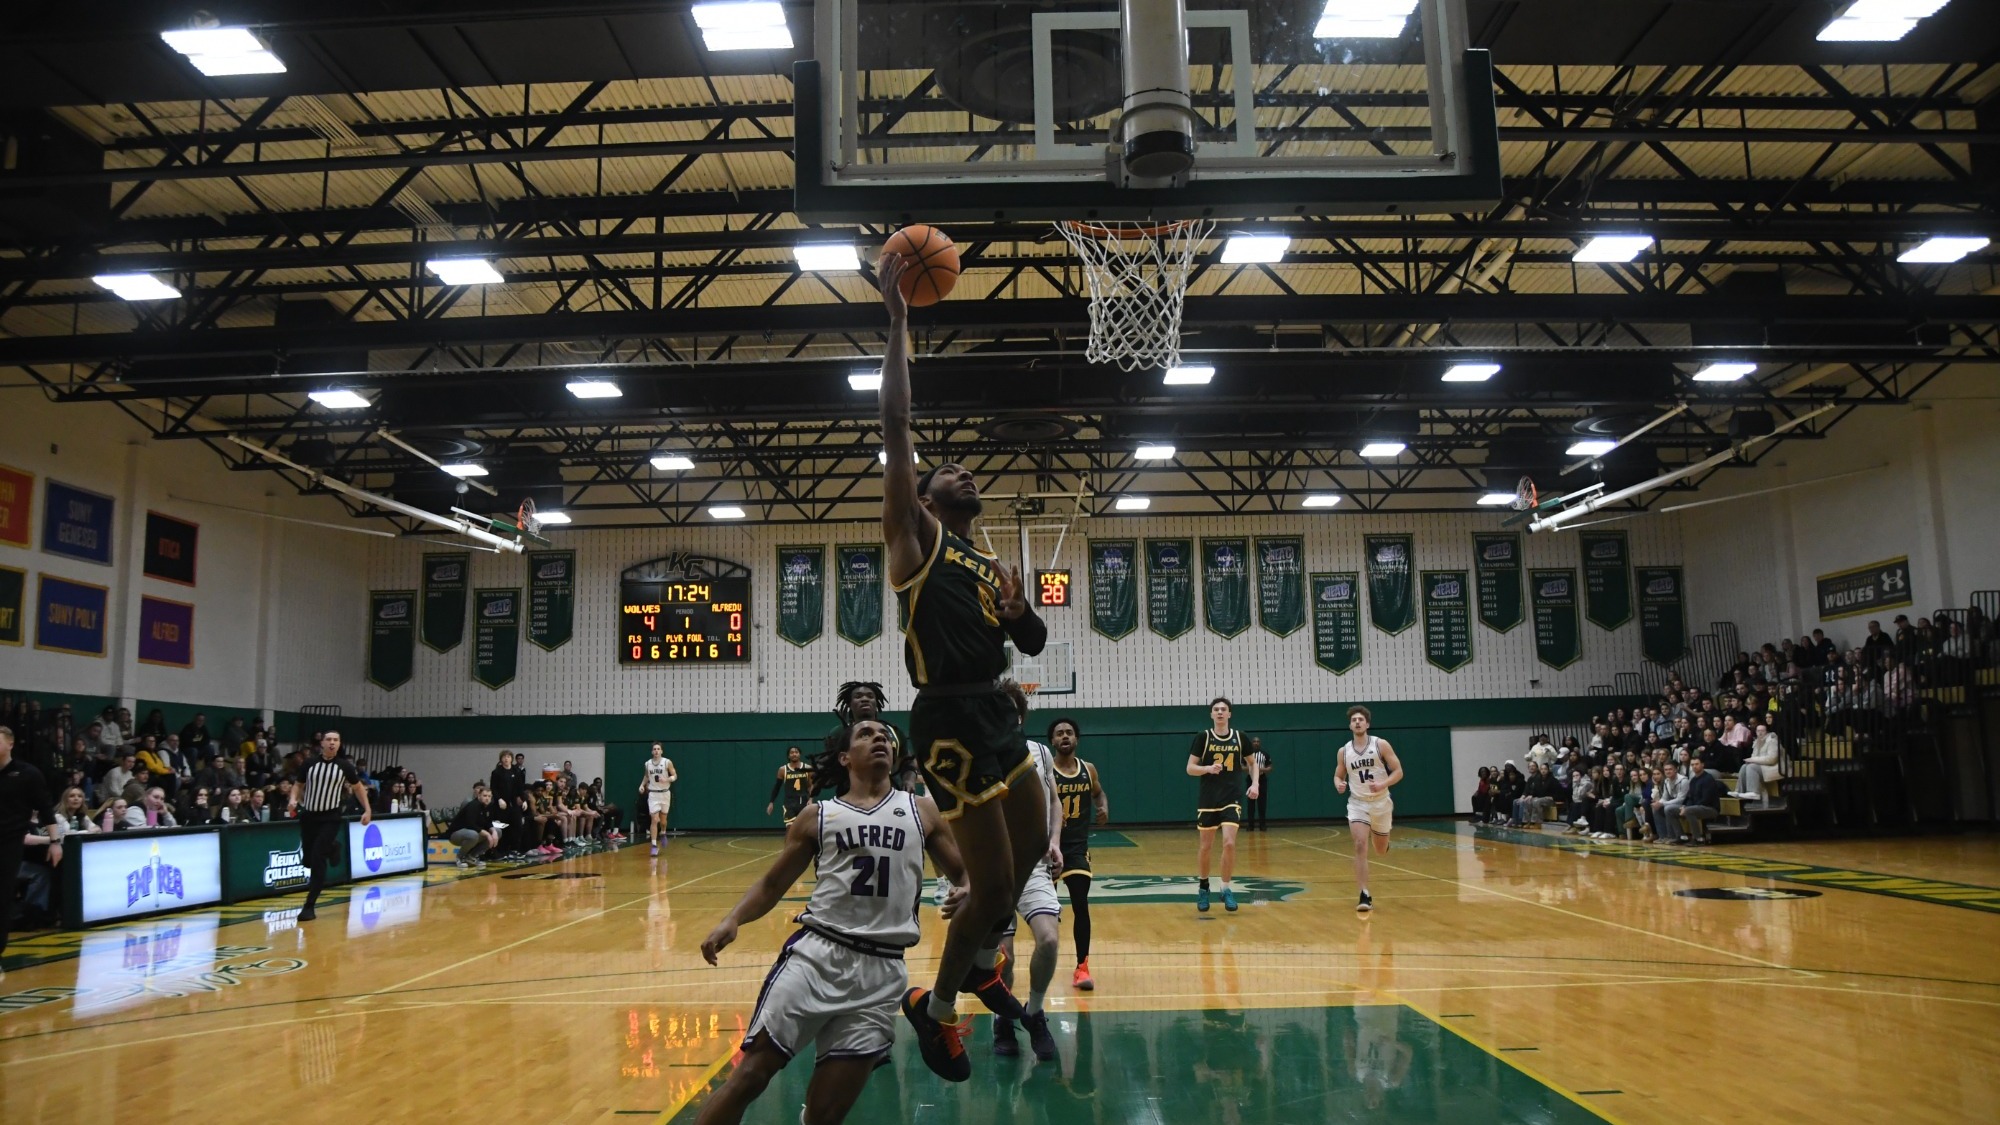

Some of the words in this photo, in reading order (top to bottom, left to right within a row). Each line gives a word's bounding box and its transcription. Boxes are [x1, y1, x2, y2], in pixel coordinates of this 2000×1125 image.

[68, 499, 93, 523] SUNY
[58, 521, 98, 550] GENESEO
[158, 537, 182, 560] UTICA
[1487, 543, 1511, 557] NEAC
[667, 551, 704, 581] KC
[852, 562, 870, 570] NCAA
[1040, 573, 1069, 586] 17:24
[667, 584, 709, 602] 17:24
[1325, 584, 1349, 598] NEAC
[1436, 582, 1459, 596] NEAC
[1544, 580, 1568, 594] NEAC
[1041, 584, 1064, 605] 28
[1824, 585, 1874, 609] WOLVES
[624, 604, 661, 614] WOLVES
[48, 603, 73, 627] SUNY
[74, 606, 97, 630] POLY
[643, 615, 655, 631] 4
[685, 616, 690, 629] 1
[730, 613, 742, 631] 0
[152, 623, 180, 642] ALFRED
[628, 635, 642, 644] FLS
[665, 634, 683, 643] PLYR
[686, 634, 704, 643] FOUL
[727, 633, 742, 642] FLS
[632, 645, 642, 660] 0
[650, 645, 660, 659] 6
[669, 644, 687, 659] 21
[695, 645, 700, 658] 1
[709, 644, 719, 658] 6
[736, 644, 742, 657] 1
[1209, 744, 1239, 752] KEUKA
[1213, 752, 1235, 772] 24
[1350, 758, 1375, 770] ALFRED
[794, 778, 800, 790] 4
[1062, 794, 1080, 818] 11
[835, 824, 906, 855] ALFRED
[364, 846, 384, 860] NCAA
[270, 853, 301, 868] KEUKA
[265, 865, 304, 884] COLLEGE
[850, 856, 890, 898] 21
